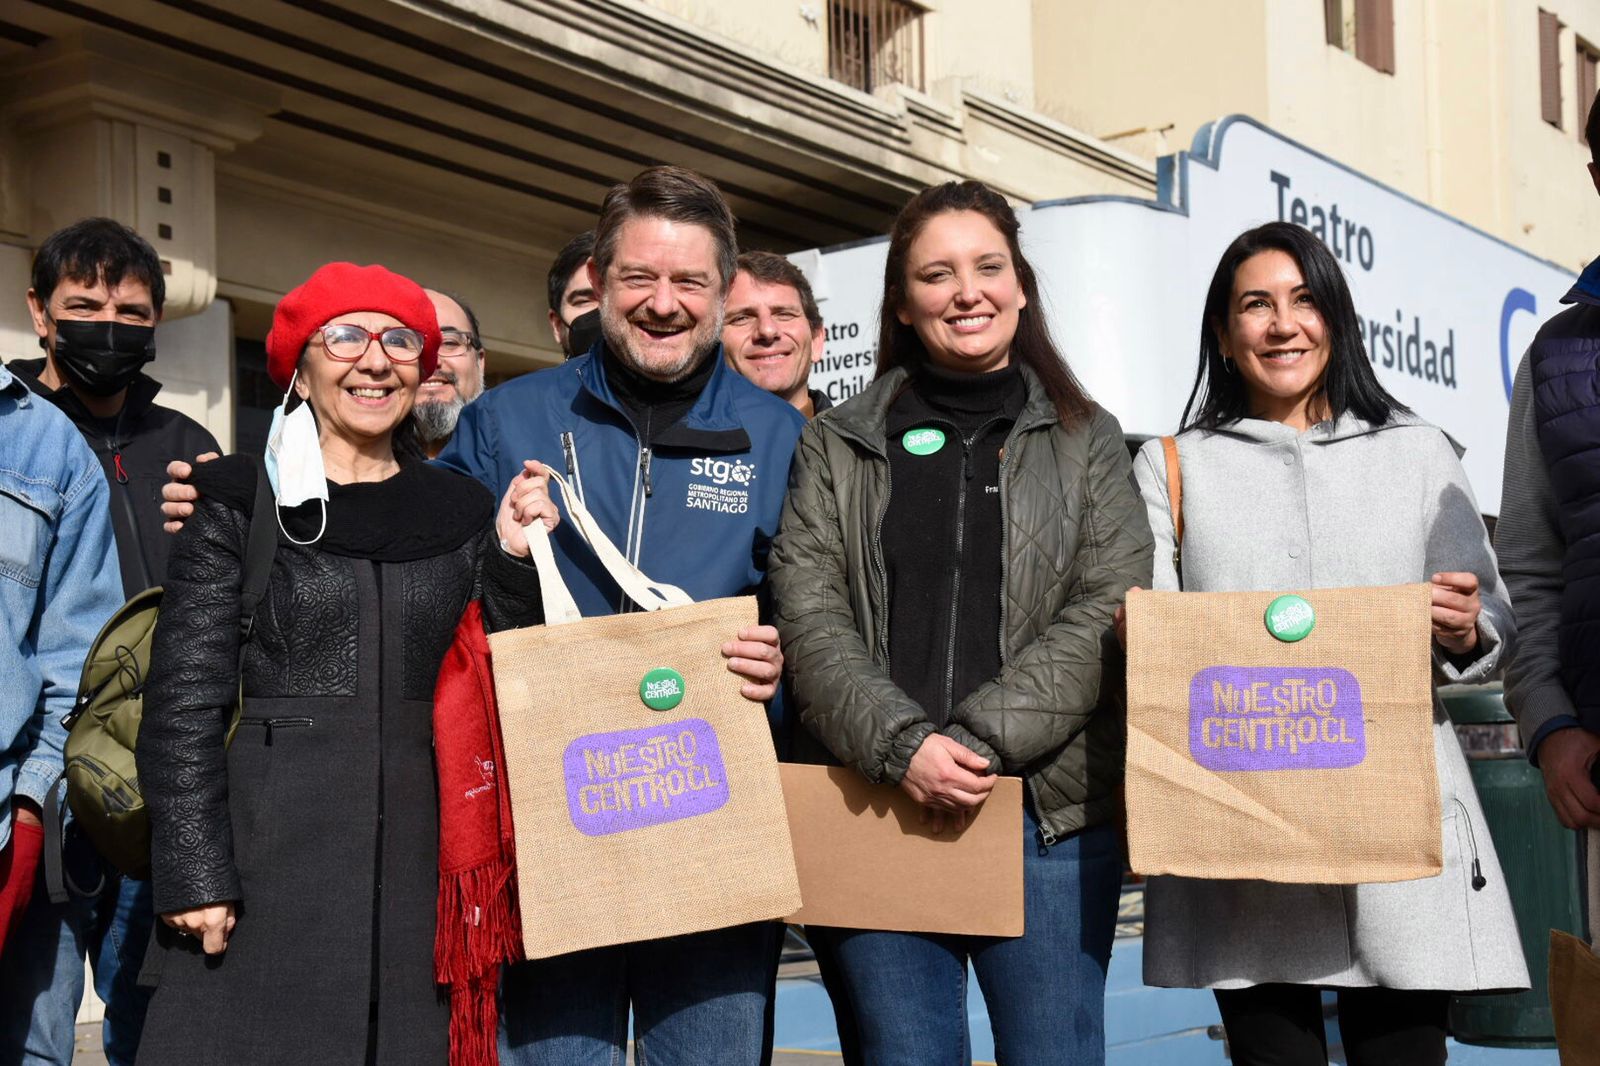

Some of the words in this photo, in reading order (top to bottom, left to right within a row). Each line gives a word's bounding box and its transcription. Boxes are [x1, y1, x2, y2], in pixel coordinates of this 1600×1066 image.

[1270, 169, 1374, 271] Teatro
[687, 490, 739, 503] METROPOLITANO
[688, 483, 719, 494] GOBIERNO
[719, 488, 749, 497] REGIONAL
[686, 497, 748, 514] SANTIAGO
[646, 678, 677, 691] NUESTRO
[1212, 678, 1338, 718] NUESTRO
[583, 730, 697, 781] NUESTRO
